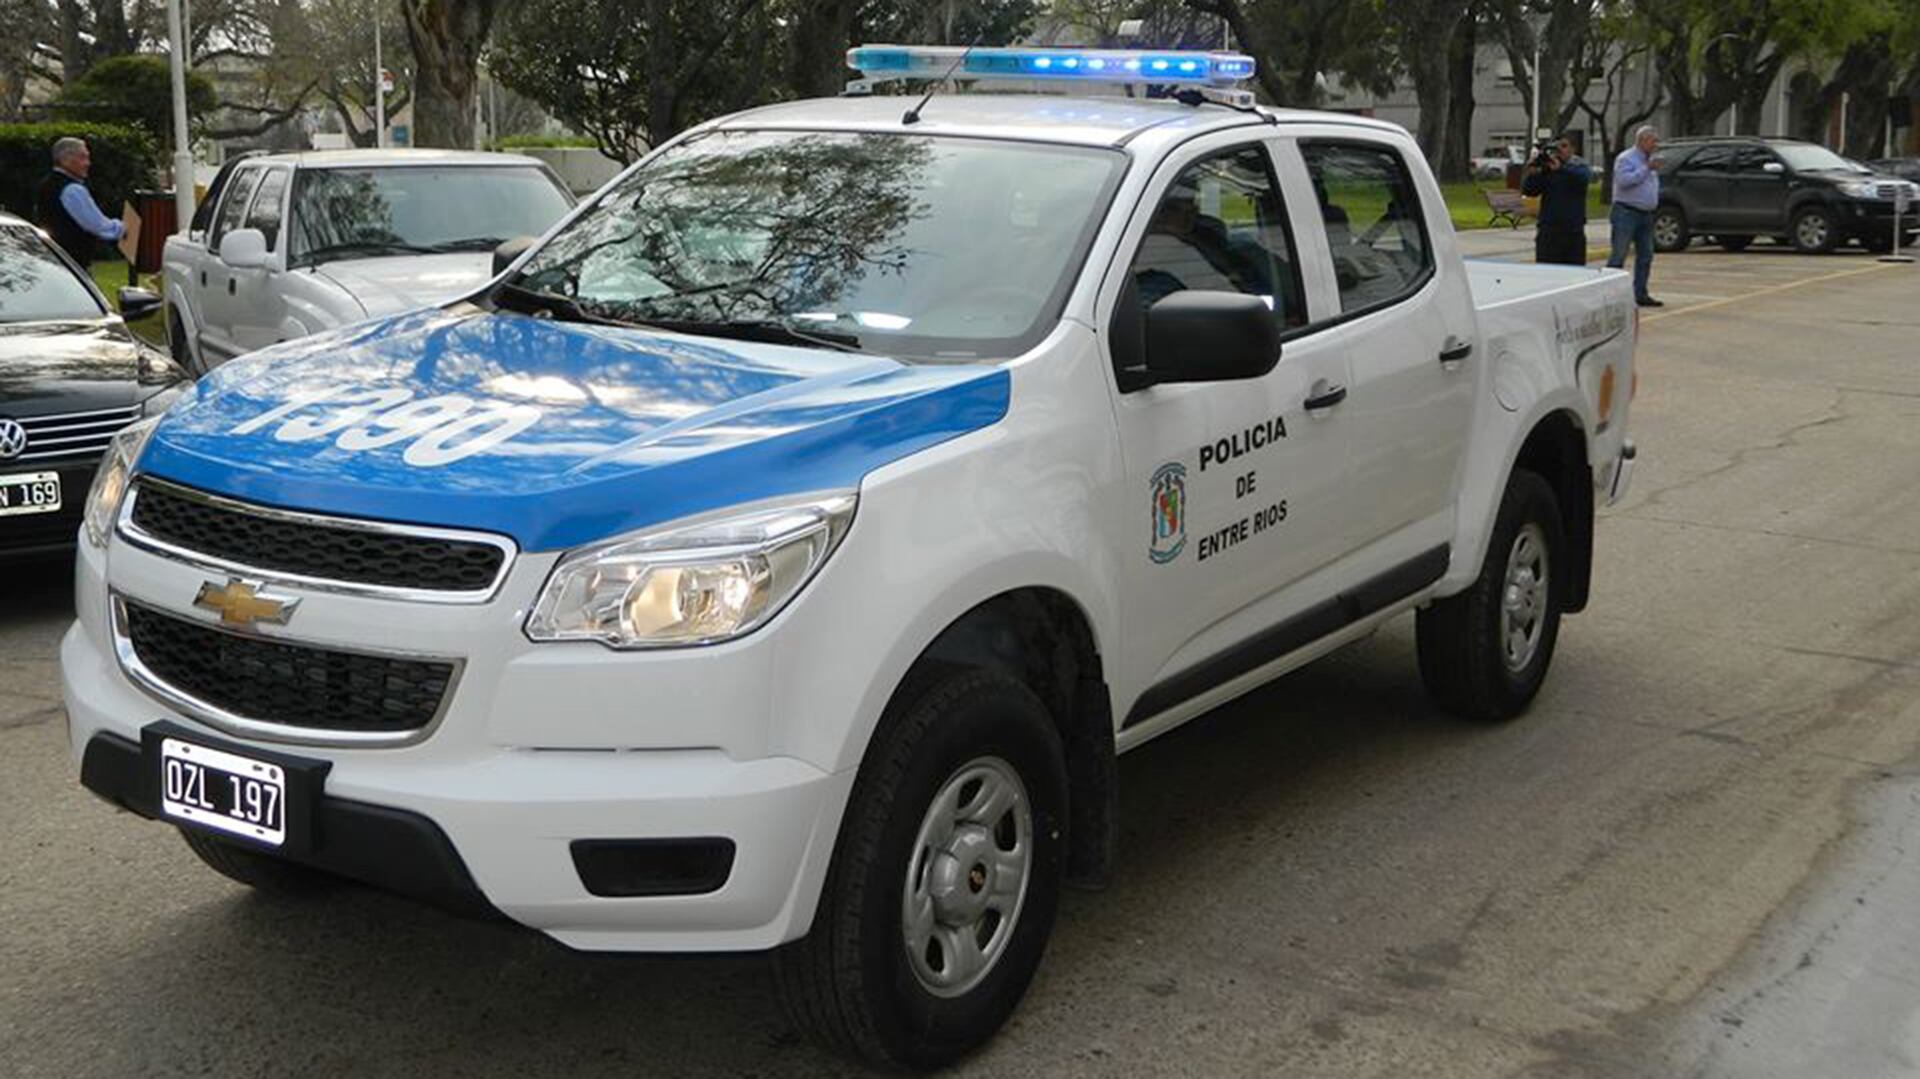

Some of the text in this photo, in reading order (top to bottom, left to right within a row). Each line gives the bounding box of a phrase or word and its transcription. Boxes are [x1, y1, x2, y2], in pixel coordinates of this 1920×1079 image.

[229, 383, 542, 467] 1390
[1199, 416, 1287, 472] POLICIA
[20, 481, 57, 505] 169
[1236, 471, 1256, 499] DE
[1197, 499, 1288, 562] ENTRE RIOS
[166, 759, 279, 826] OZL 197
